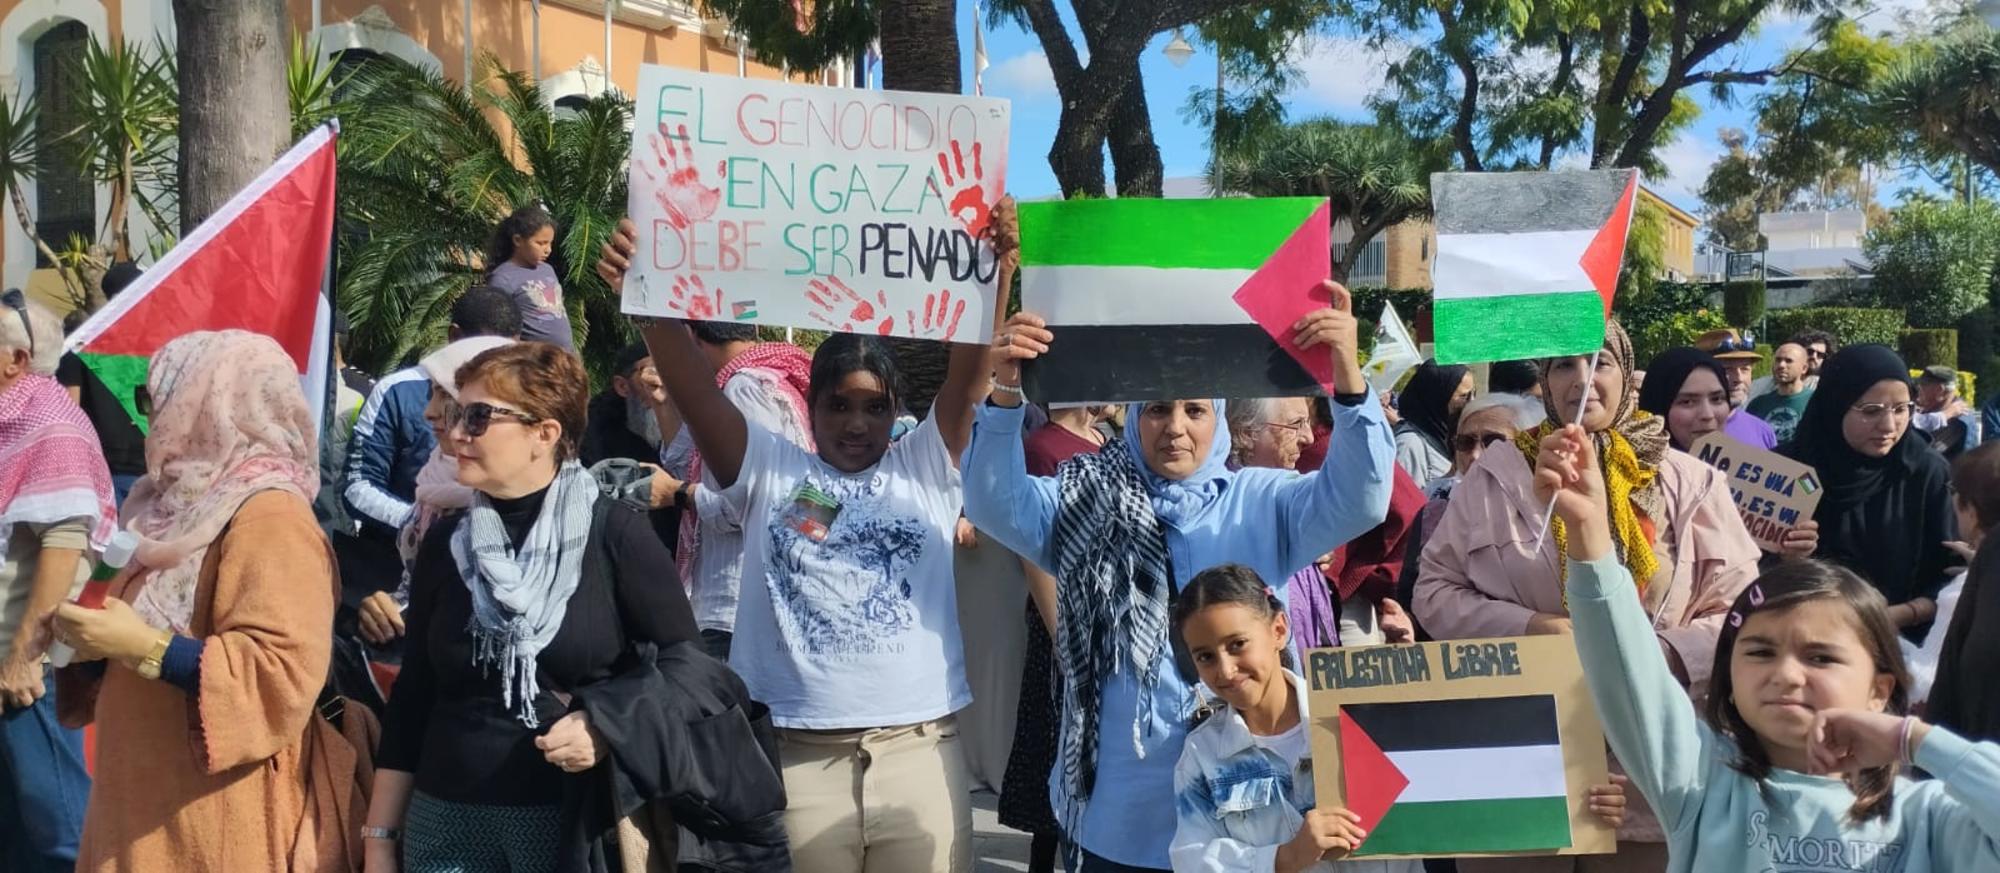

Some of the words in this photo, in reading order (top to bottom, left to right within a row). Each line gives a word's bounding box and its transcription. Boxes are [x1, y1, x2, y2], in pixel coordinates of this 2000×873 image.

[657, 84, 728, 146] EL
[736, 93, 977, 158] GENOCIDIO
[727, 156, 795, 210] EN
[809, 163, 948, 214] GAZA
[652, 218, 767, 271] DEBE
[783, 222, 854, 277] SER
[859, 222, 1000, 284] PENADO
[1734, 461, 1763, 484] ES
[1764, 471, 1796, 498] UNA
[1778, 506, 1801, 526] UN
